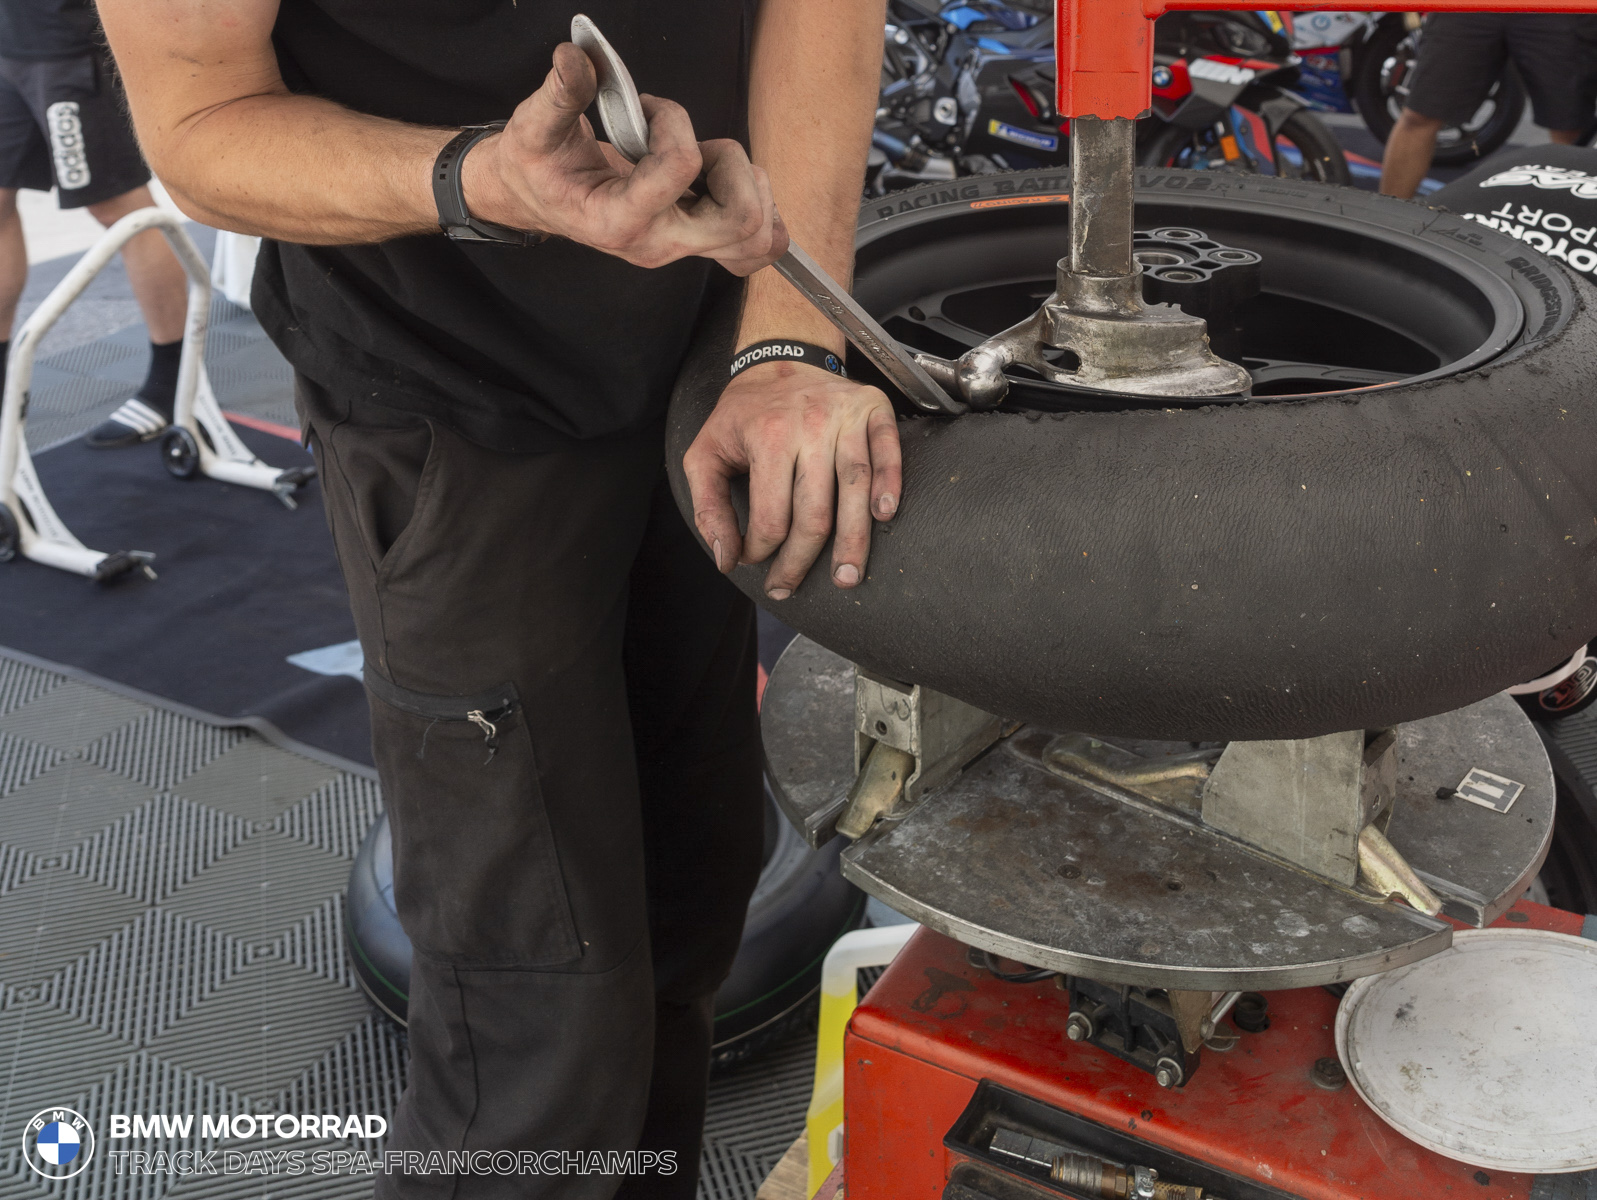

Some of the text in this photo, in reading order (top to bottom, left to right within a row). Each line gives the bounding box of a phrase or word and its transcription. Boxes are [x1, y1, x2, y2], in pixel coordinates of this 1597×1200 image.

[876, 184, 980, 220] RACING
[993, 175, 1070, 196] BATT
[730, 344, 805, 377] MOTORRAD
